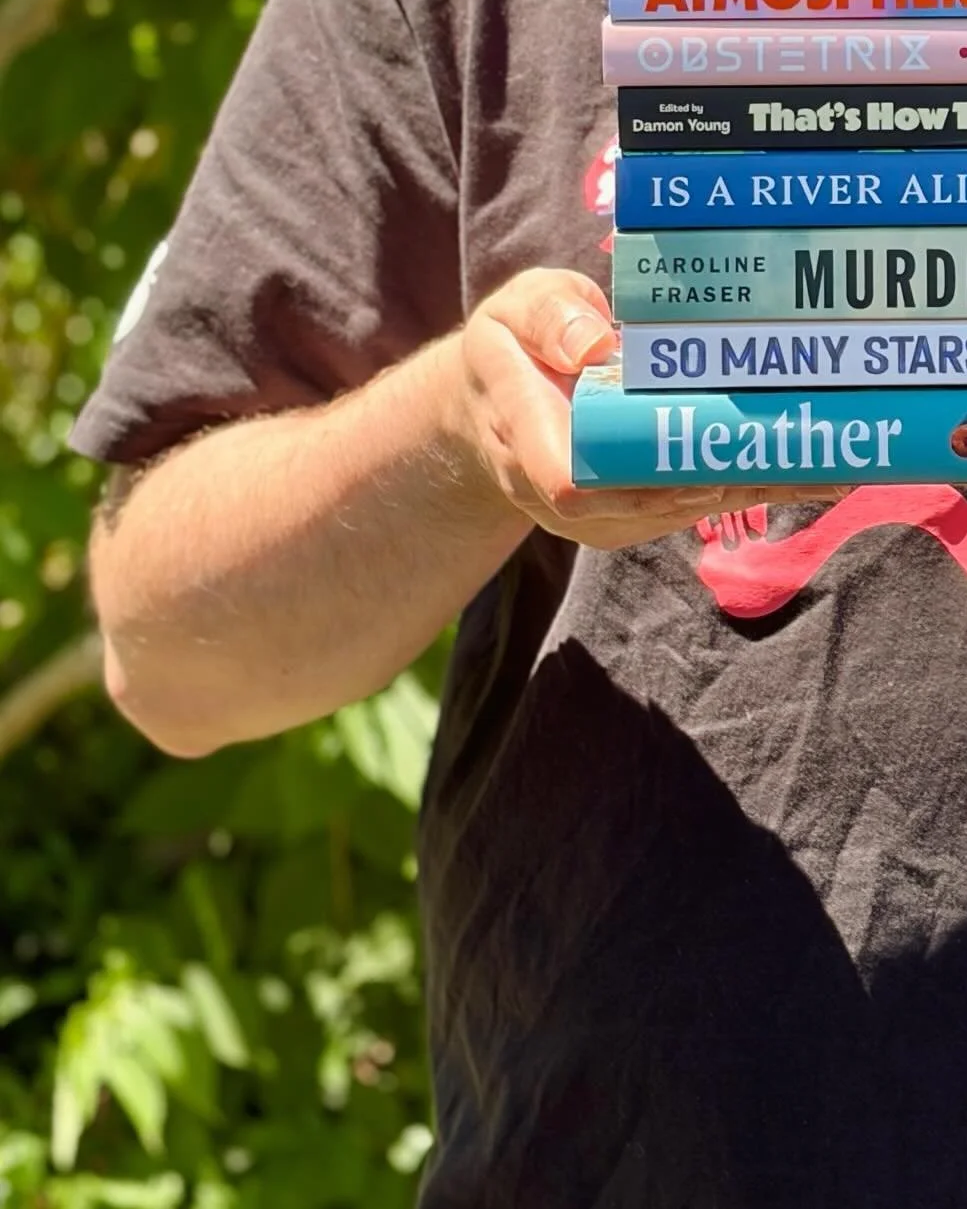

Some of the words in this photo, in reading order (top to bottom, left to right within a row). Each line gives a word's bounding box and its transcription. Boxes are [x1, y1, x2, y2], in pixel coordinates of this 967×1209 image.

[638, 35, 931, 73] OBSTETRIX
[659, 103, 689, 113] Edited
[691, 103, 704, 115] by
[748, 101, 863, 133] That’s
[867, 102, 949, 132] How
[632, 118, 684, 133] Damon
[686, 118, 731, 135] Young
[651, 177, 691, 208] IS
[706, 176, 736, 207] A
[751, 175, 883, 206] RIVER
[637, 255, 767, 274] CAROLINE
[651, 286, 752, 304] FRASER
[650, 337, 707, 379] SO
[721, 335, 849, 376] MANY
[655, 401, 903, 473] Heather
